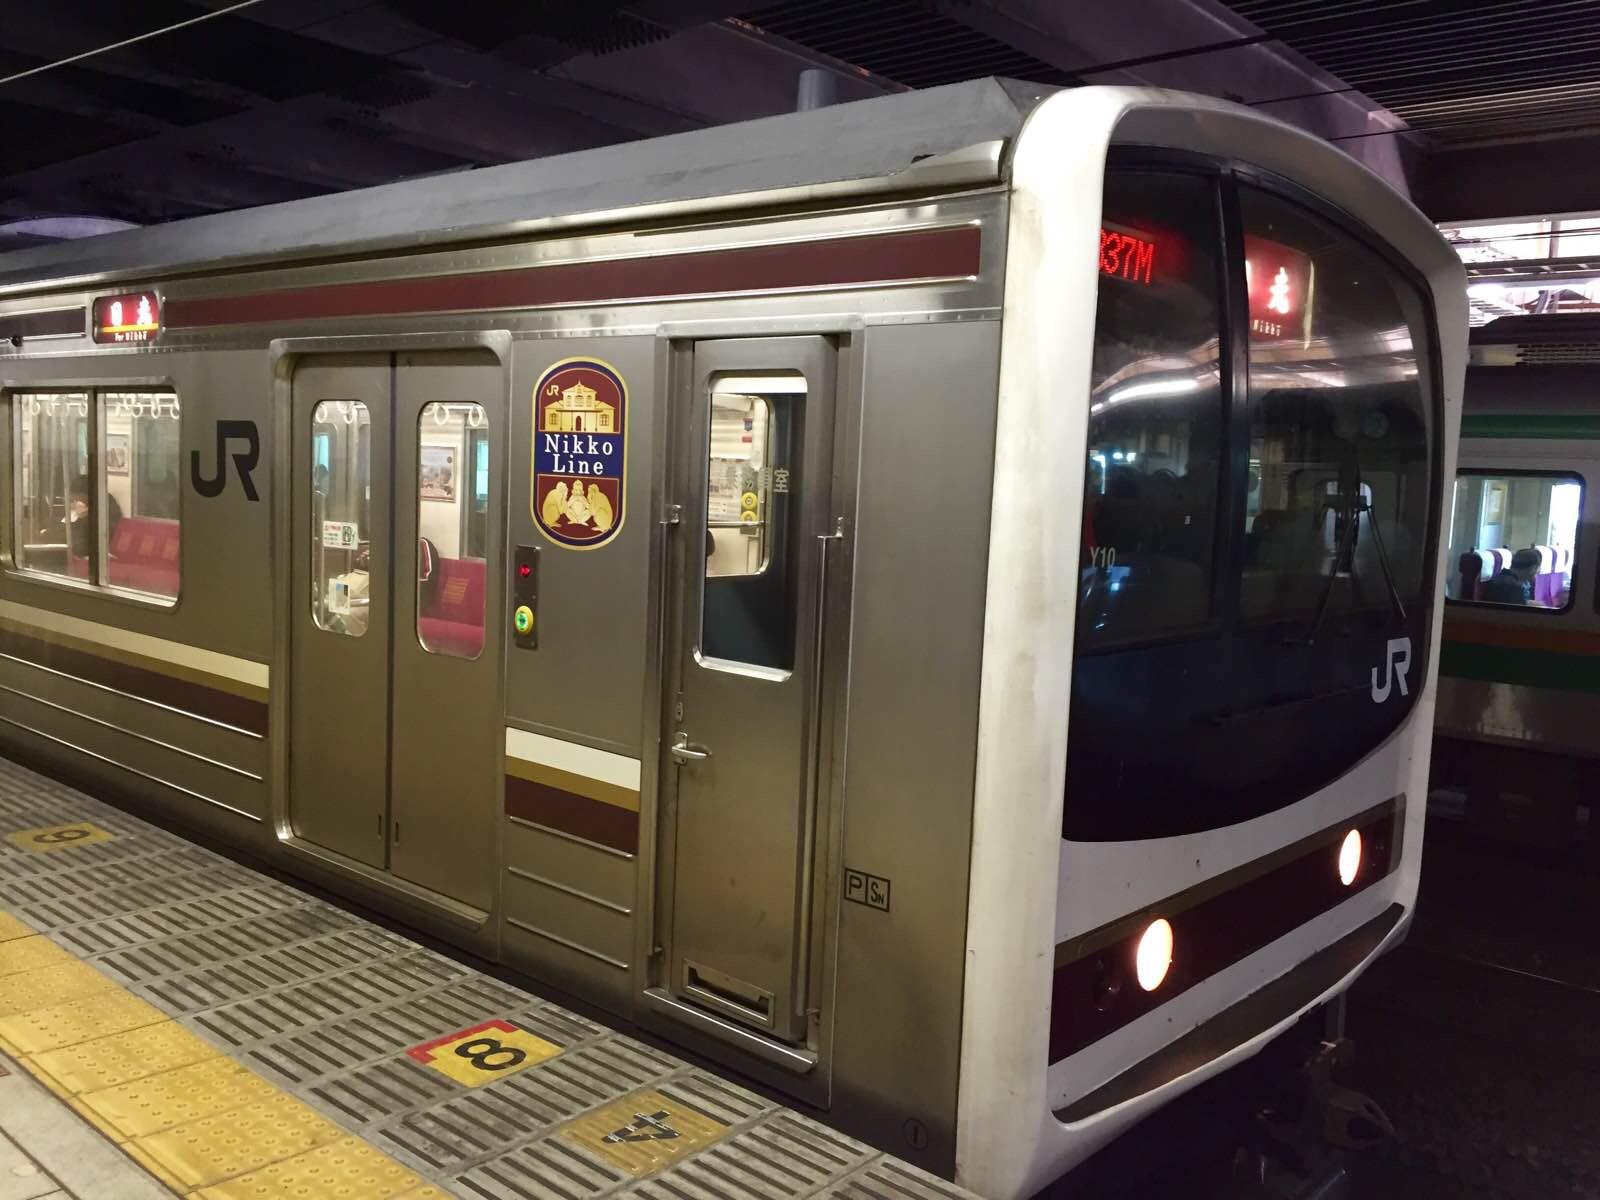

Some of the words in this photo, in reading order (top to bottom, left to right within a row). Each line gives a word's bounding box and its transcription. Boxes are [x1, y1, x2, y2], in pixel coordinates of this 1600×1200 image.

[546, 384, 560, 397] JR
[544, 433, 613, 456] Nikko
[191, 420, 260, 501] JR
[552, 453, 604, 475] Line
[1089, 546, 1116, 571] Y10
[1371, 637, 1412, 704] JR
[455, 1038, 528, 1072] 8
[601, 1110, 682, 1144] 4
